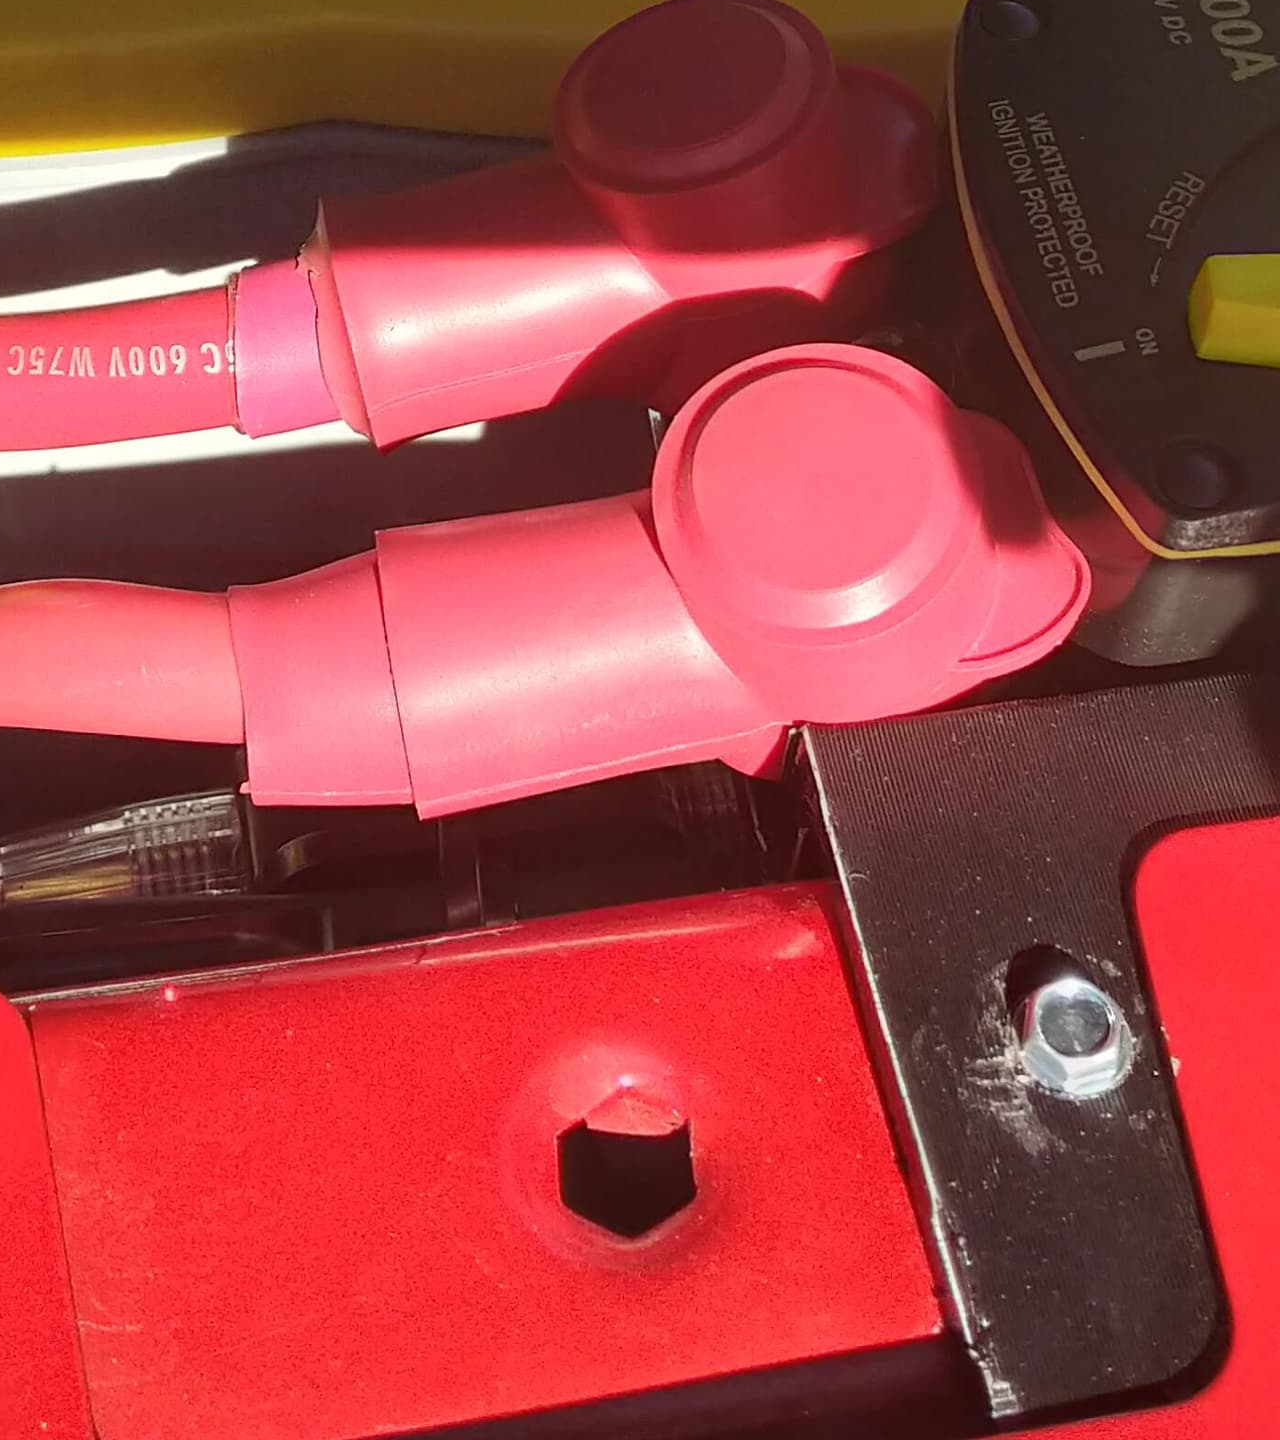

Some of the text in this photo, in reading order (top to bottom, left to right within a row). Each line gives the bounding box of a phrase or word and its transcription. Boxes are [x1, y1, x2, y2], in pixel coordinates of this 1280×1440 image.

[1160, 15, 1193, 46] DC
[987, 98, 1080, 311] IGNITION PROTECTED
[1025, 111, 1104, 277] WEATHERPROOF
[1144, 170, 1206, 249] RESET
[1134, 326, 1159, 357] ON
[6, 344, 96, 377] W75C
[109, 343, 188, 377] 600V
